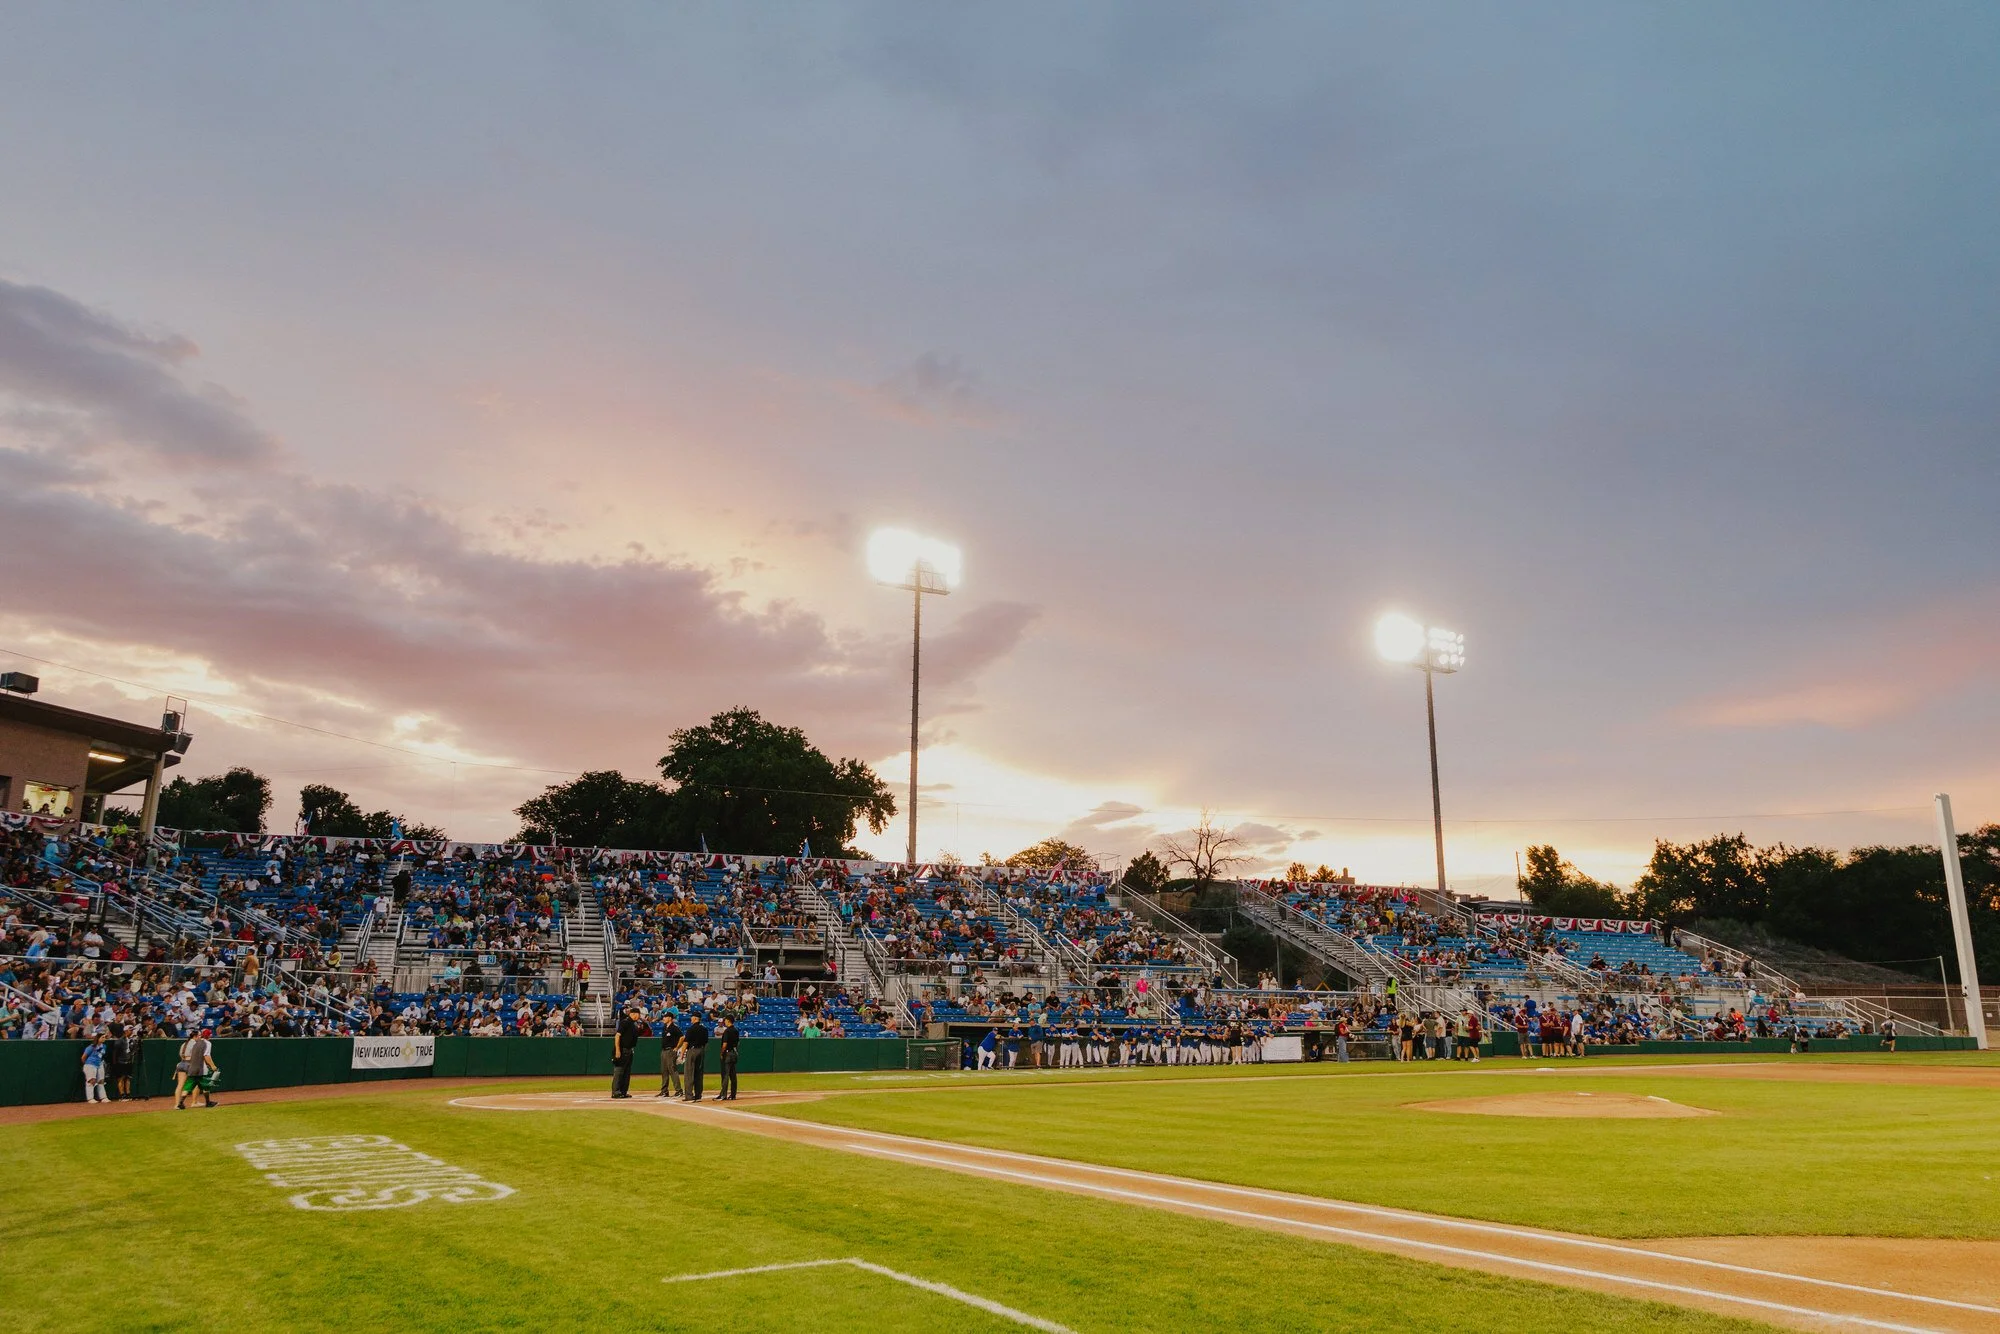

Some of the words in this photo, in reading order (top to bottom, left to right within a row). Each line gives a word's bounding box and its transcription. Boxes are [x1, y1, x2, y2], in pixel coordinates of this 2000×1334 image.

[354, 1046, 372, 1058] NEW
[372, 1046, 400, 1058] MEXICO
[415, 1045, 433, 1057] TRUE
